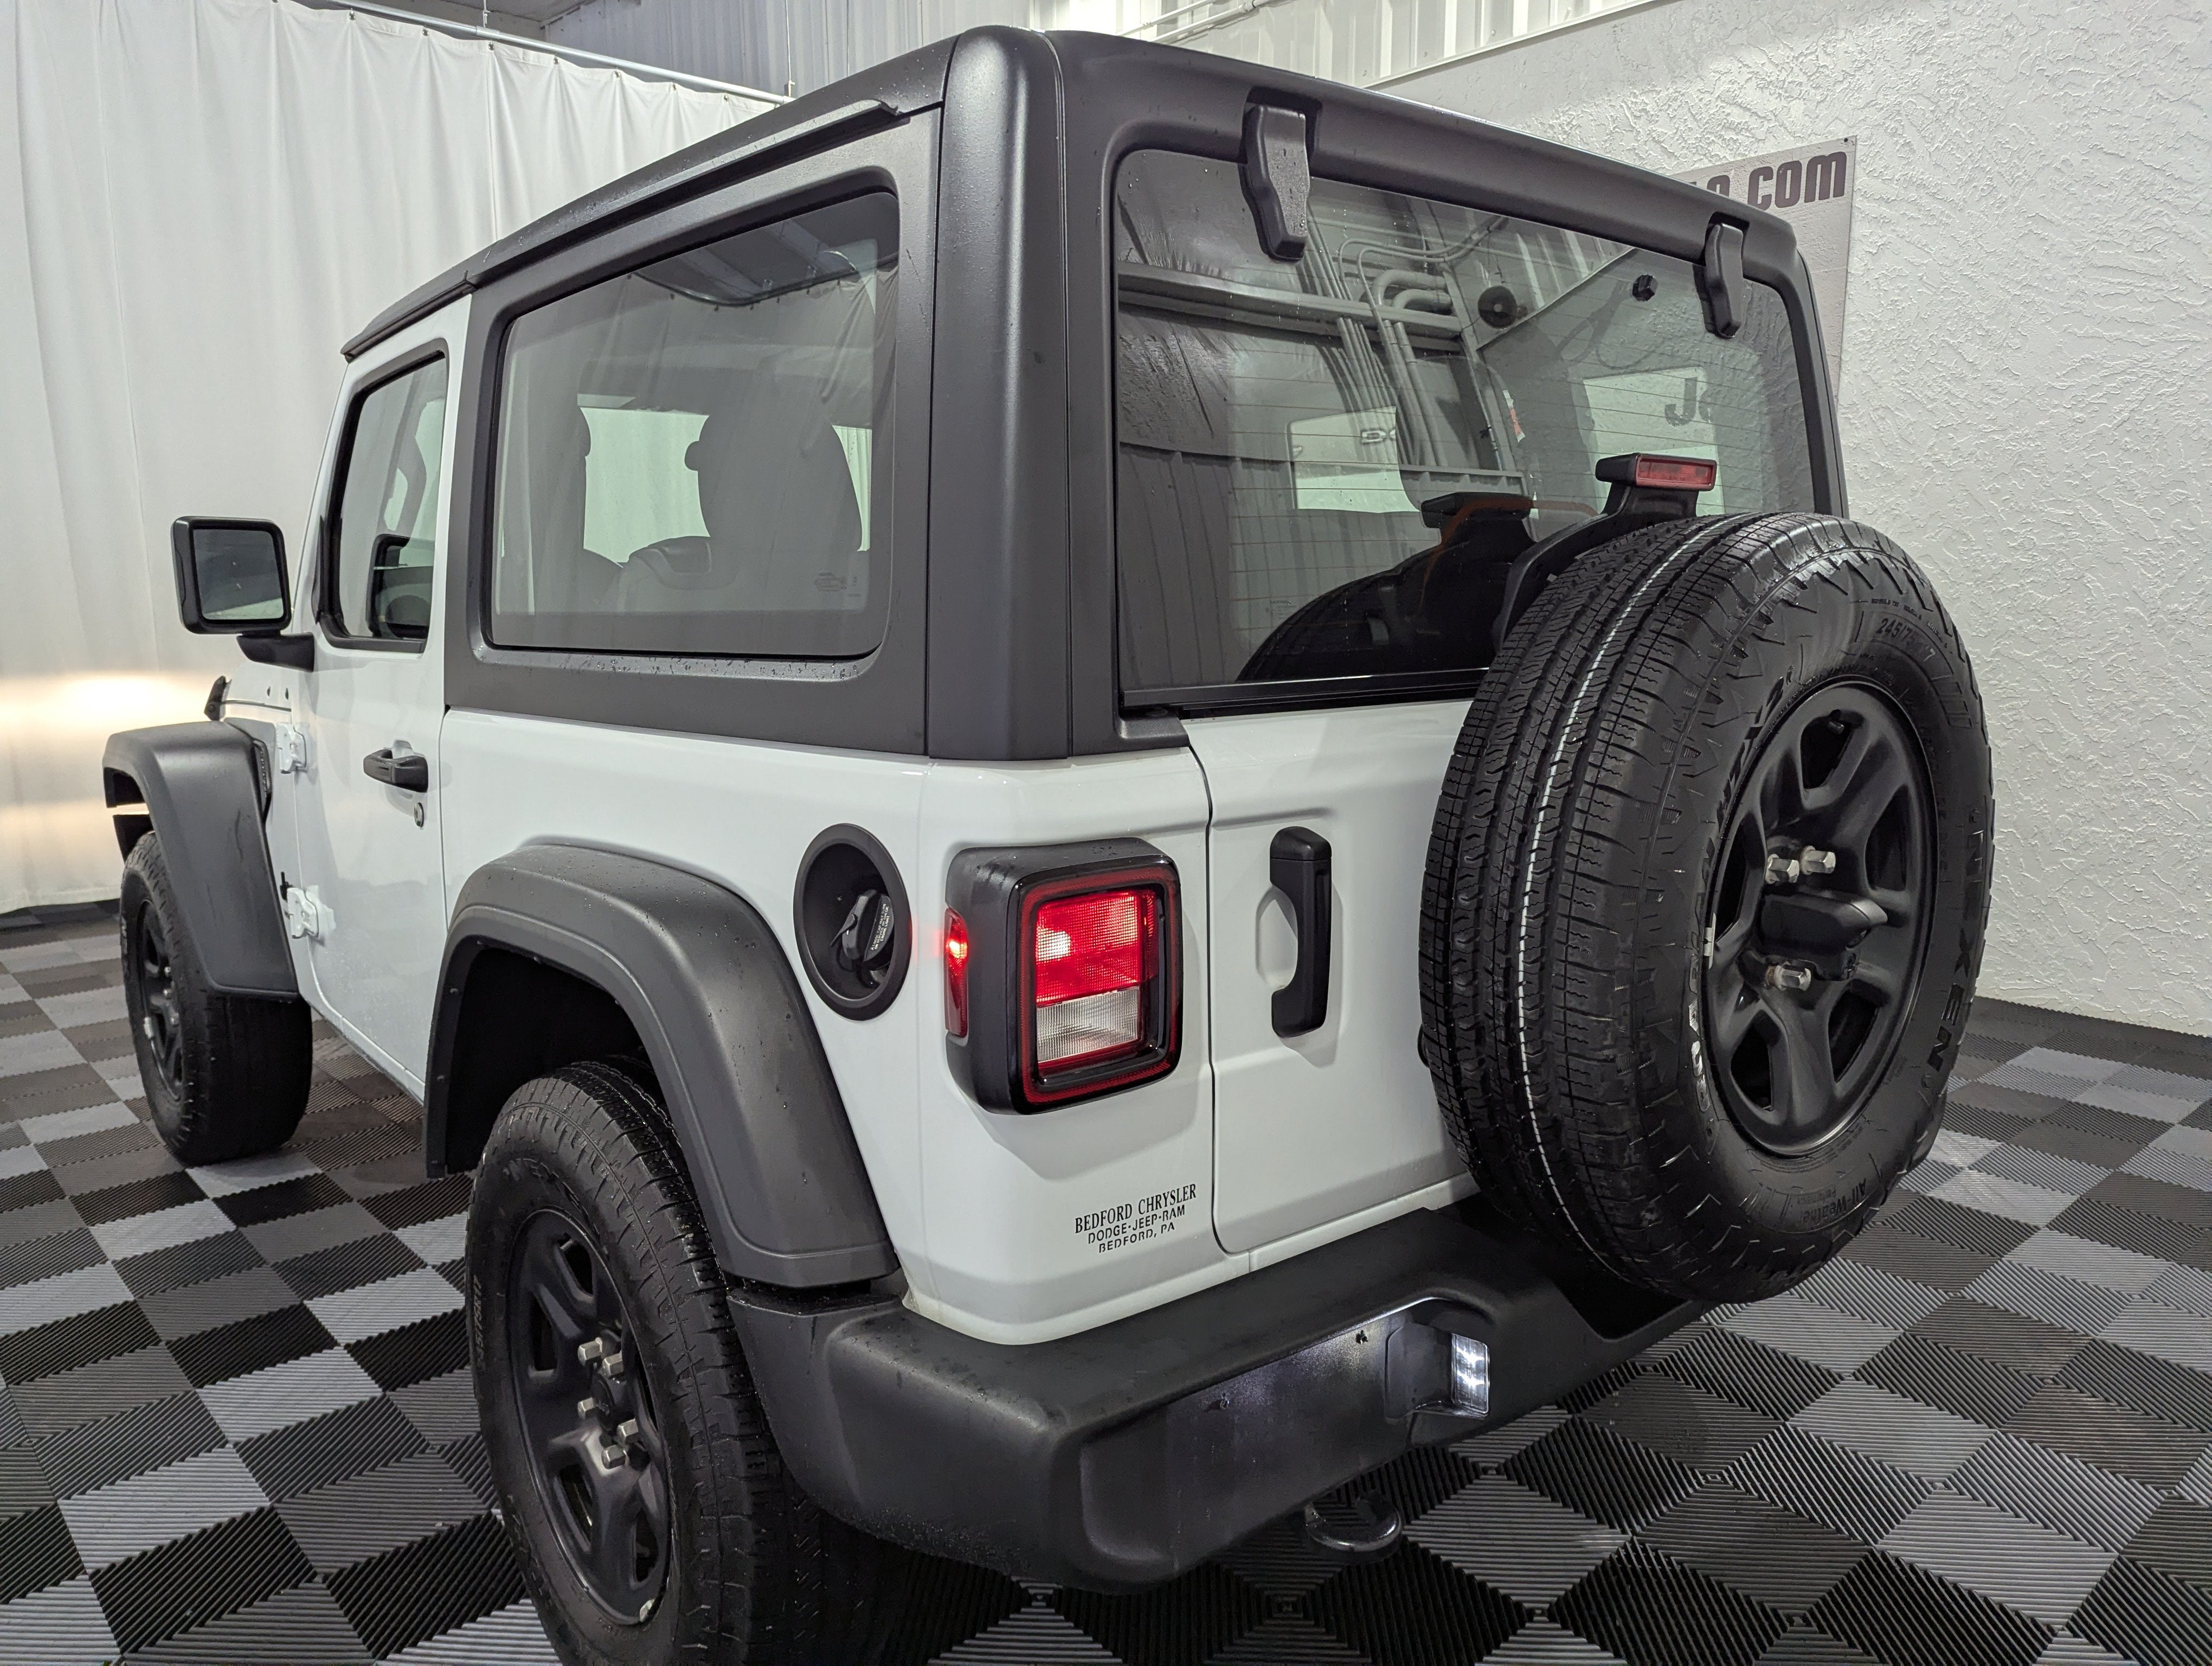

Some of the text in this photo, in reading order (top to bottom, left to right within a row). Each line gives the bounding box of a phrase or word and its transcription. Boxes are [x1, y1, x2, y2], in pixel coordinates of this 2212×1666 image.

[1075, 1183, 1197, 1234] BEDFORD CHRYSLER
[1098, 1222, 1175, 1253] BEDFORD, PA
